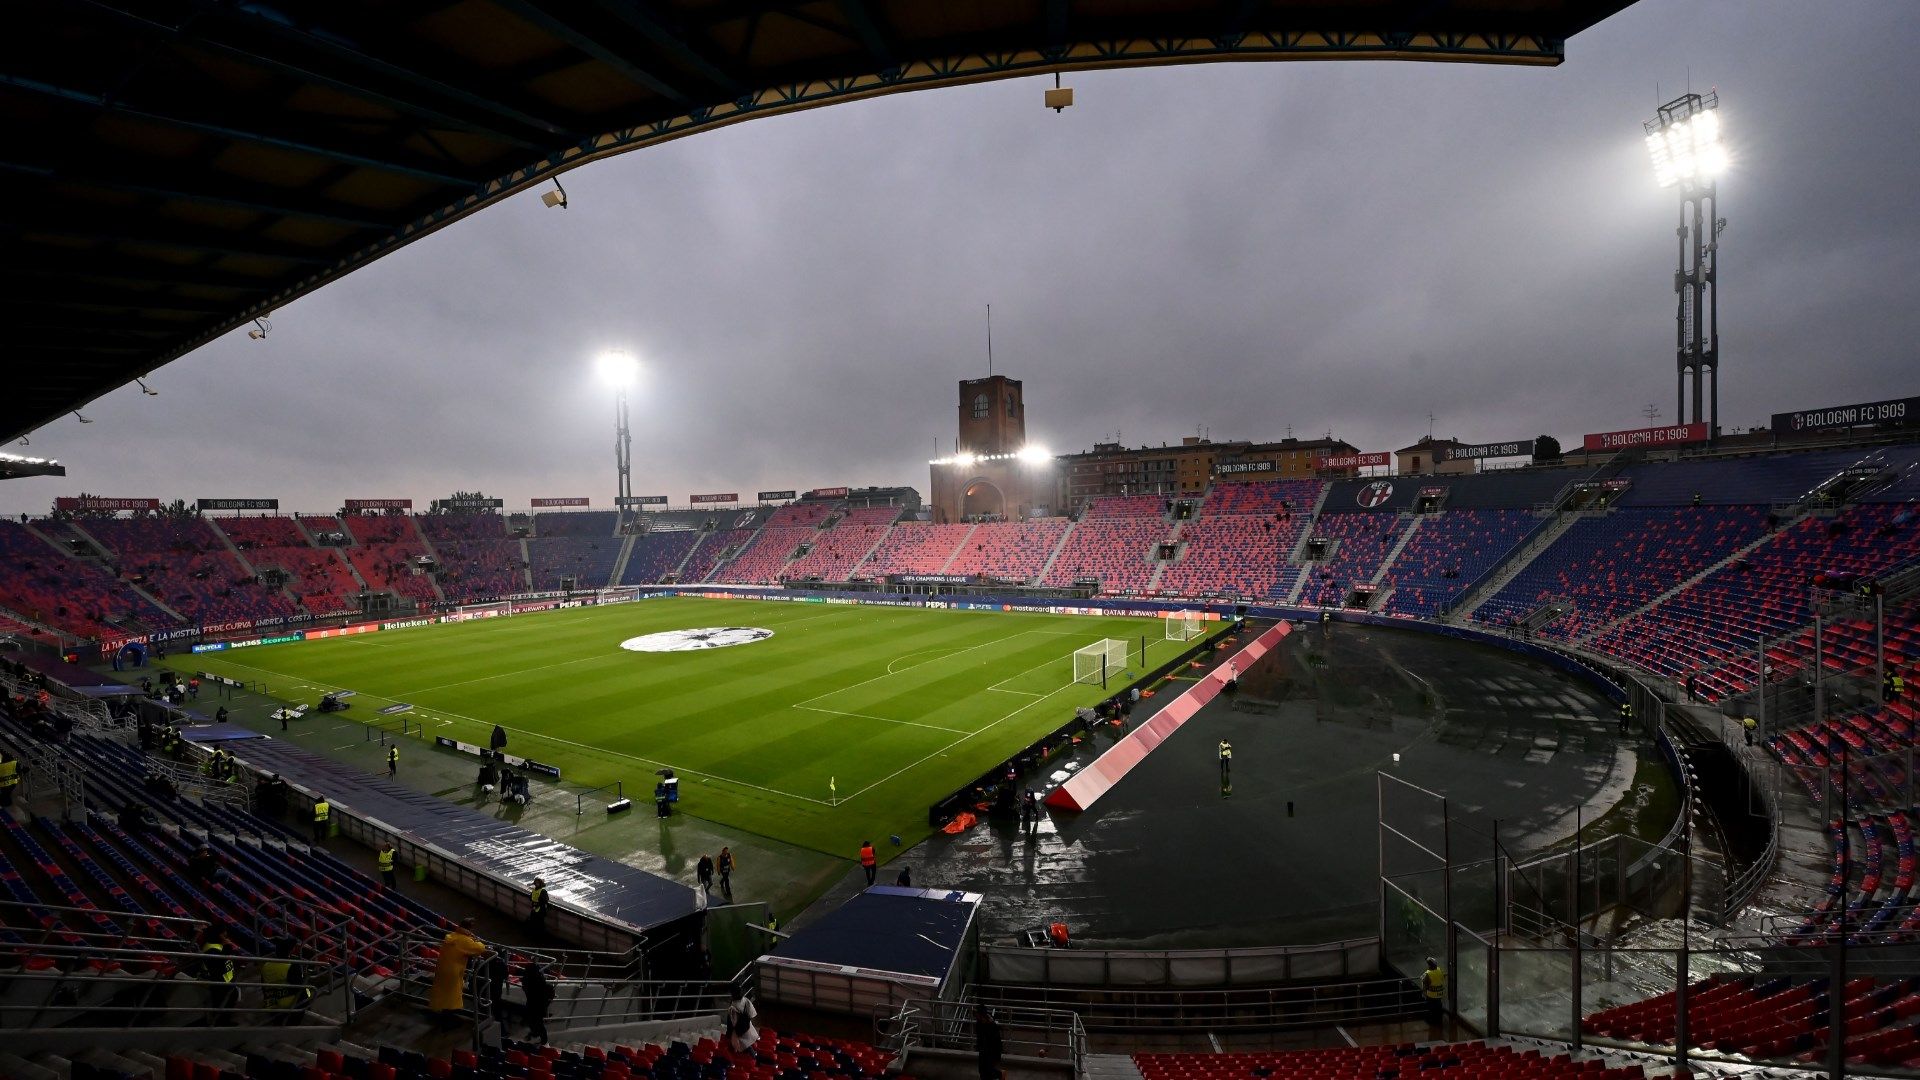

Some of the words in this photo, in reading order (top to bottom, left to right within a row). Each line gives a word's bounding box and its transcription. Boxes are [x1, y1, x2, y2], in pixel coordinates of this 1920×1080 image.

[1806, 409, 1857, 427] BOLOGNA
[1861, 407, 1875, 421] FC
[1878, 402, 1906, 419] 1909
[1612, 431, 1651, 446] BOLOGNA
[1654, 430, 1665, 441] FC
[1667, 428, 1688, 440] 1909
[1455, 446, 1488, 458] BOLOGNA
[1490, 446, 1499, 455] FC
[1501, 445, 1518, 454] 1909
[1328, 458, 1357, 467] BOLOGNA
[1358, 456, 1367, 465] FC
[1368, 455, 1383, 464] 1909
[1222, 464, 1247, 473] BOLOGNA
[1248, 463, 1256, 471] FC
[1257, 462, 1271, 471] 1909
[86, 500, 121, 508] BOLOGNA
[122, 500, 131, 508] FC
[132, 500, 149, 508] 1909
[522, 605, 546, 613] AIRWAYS
[925, 601, 948, 609] PEPSI
[1012, 605, 1050, 613] mastercard
[225, 621, 252, 630] CURVA
[255, 617, 284, 627] ANDREA
[287, 614, 312, 623] COSTA
[384, 619, 428, 630] Heineken
[101, 643, 110, 652] LA
[158, 632, 168, 640] LA
[170, 628, 200, 639] NOSTRA
[203, 624, 225, 634] FEDE
[231, 639, 261, 648] bet365
